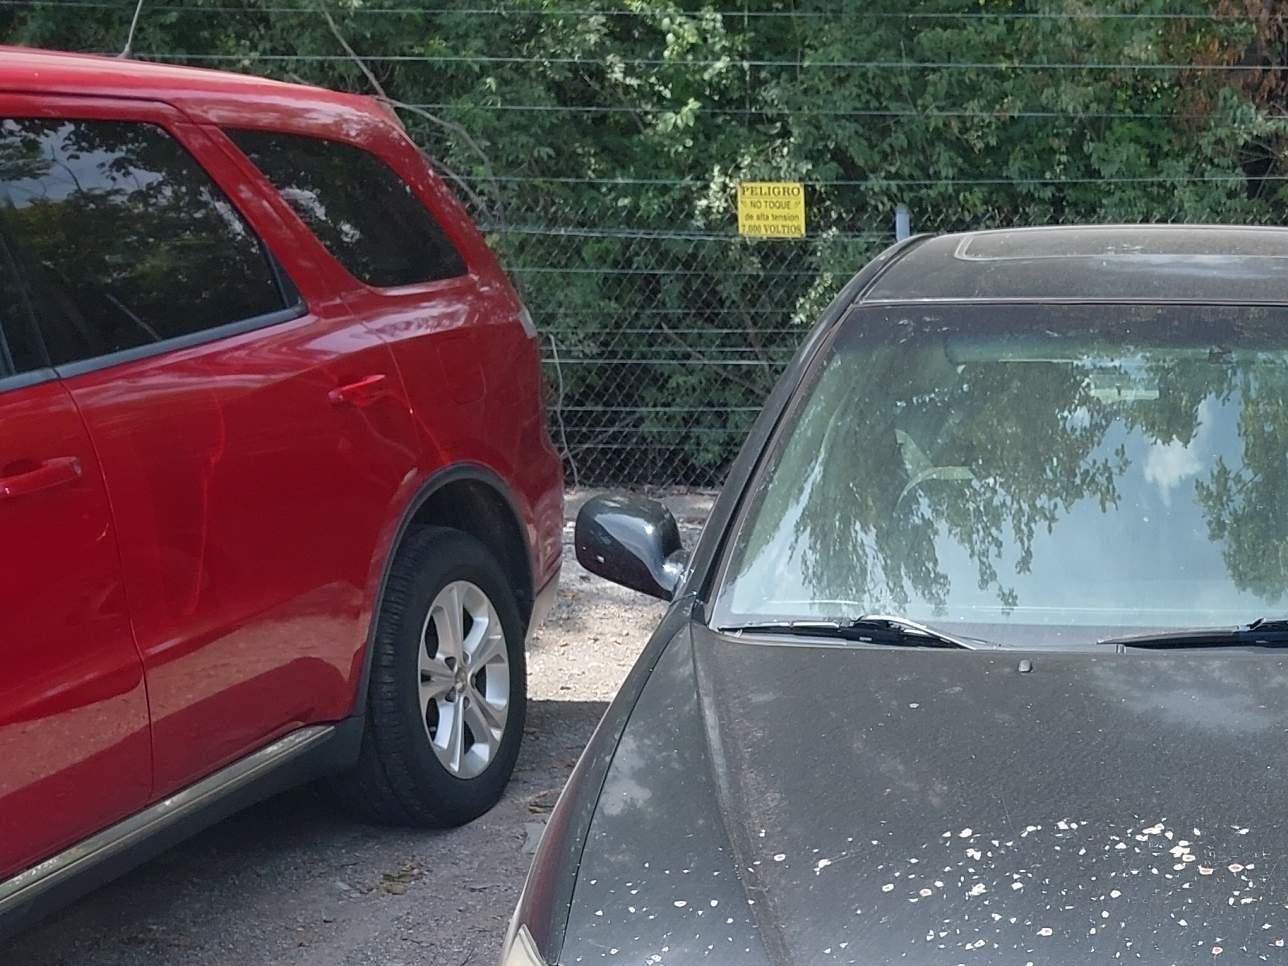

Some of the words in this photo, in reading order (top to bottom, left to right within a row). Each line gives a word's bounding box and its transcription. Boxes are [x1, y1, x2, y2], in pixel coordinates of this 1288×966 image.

[742, 186, 800, 196] PELIGRO
[750, 200, 761, 209] NO
[764, 200, 790, 209] TOQUE
[757, 213, 769, 221] alta
[763, 224, 801, 234] VOLTIOS
